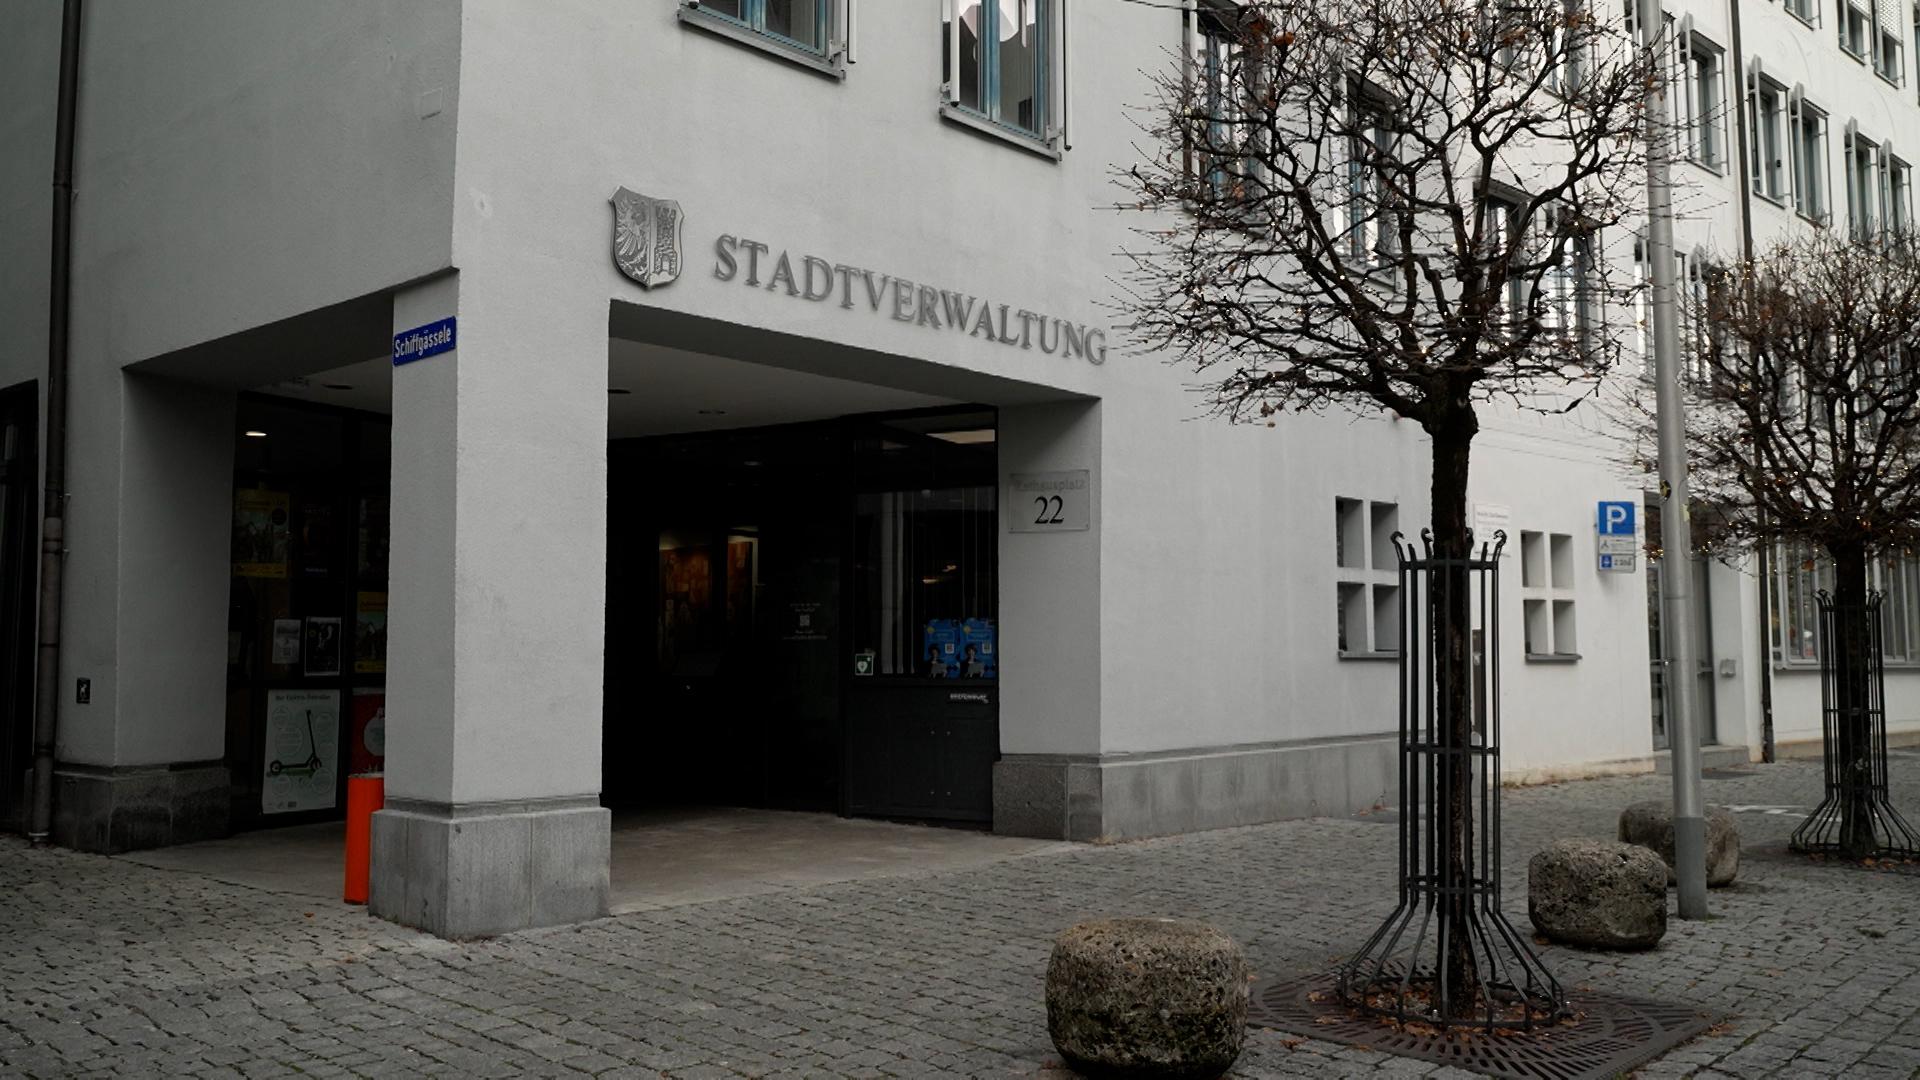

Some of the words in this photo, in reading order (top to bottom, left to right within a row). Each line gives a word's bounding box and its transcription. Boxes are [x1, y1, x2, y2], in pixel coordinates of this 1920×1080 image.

[713, 233, 1108, 366] STADTVERWALTUNG
[395, 324, 452, 358] Schiffgässele
[1034, 495, 1064, 524] 22
[1606, 505, 1627, 534] P
